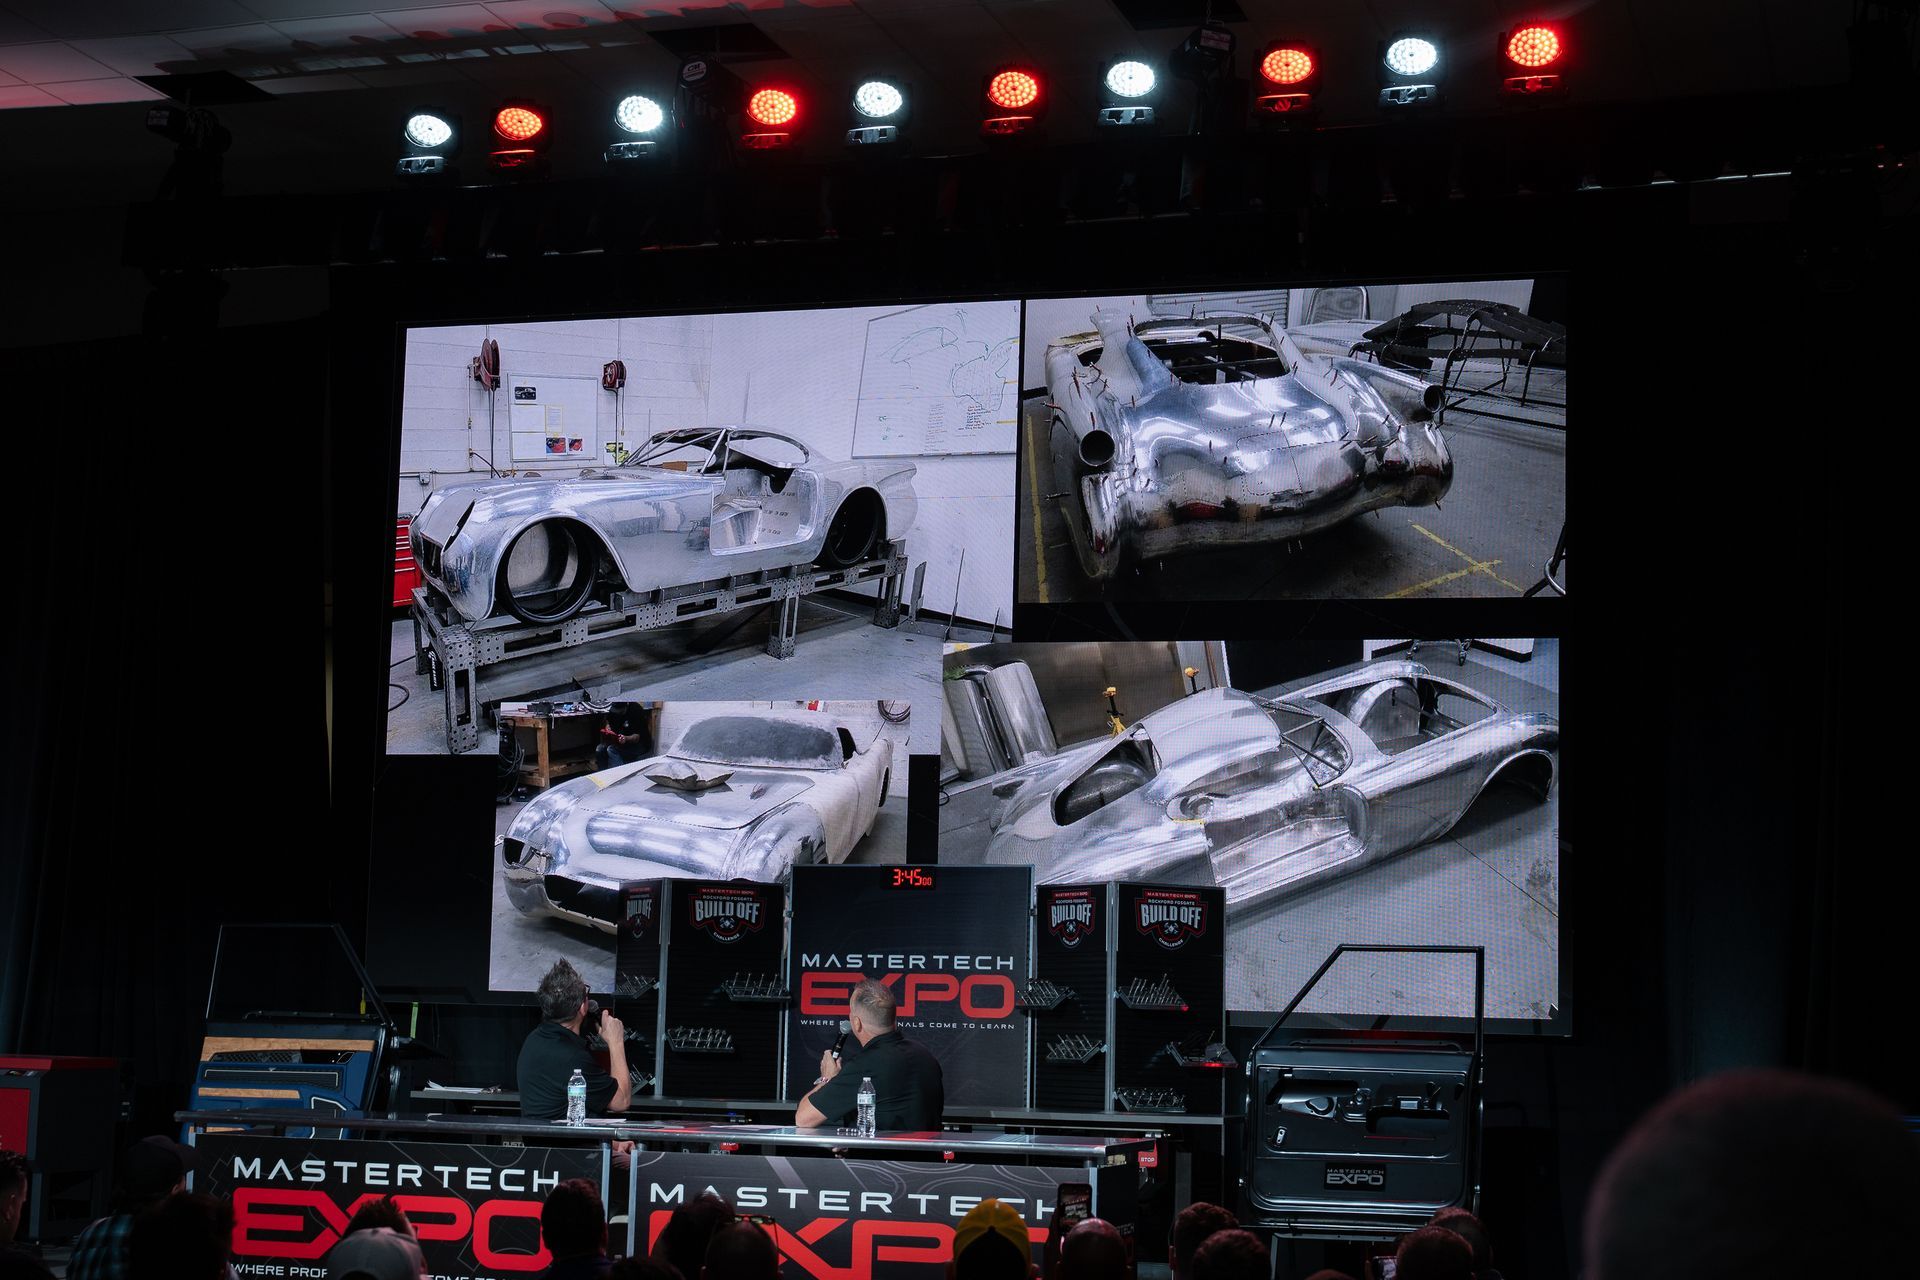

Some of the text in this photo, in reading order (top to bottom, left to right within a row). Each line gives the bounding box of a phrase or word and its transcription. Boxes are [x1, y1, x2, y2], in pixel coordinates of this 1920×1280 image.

[695, 900, 760, 924] BUILD OFF
[1051, 903, 1092, 928] BUILD OFF
[1140, 903, 1202, 929] BUILD OFF
[801, 953, 1014, 971] MASTERTECH
[800, 1019, 835, 1027] WHERE
[233, 1156, 559, 1192] MASTERTECH
[1326, 1173, 1384, 1186] EXPO
[229, 1263, 285, 1277] WHERE
